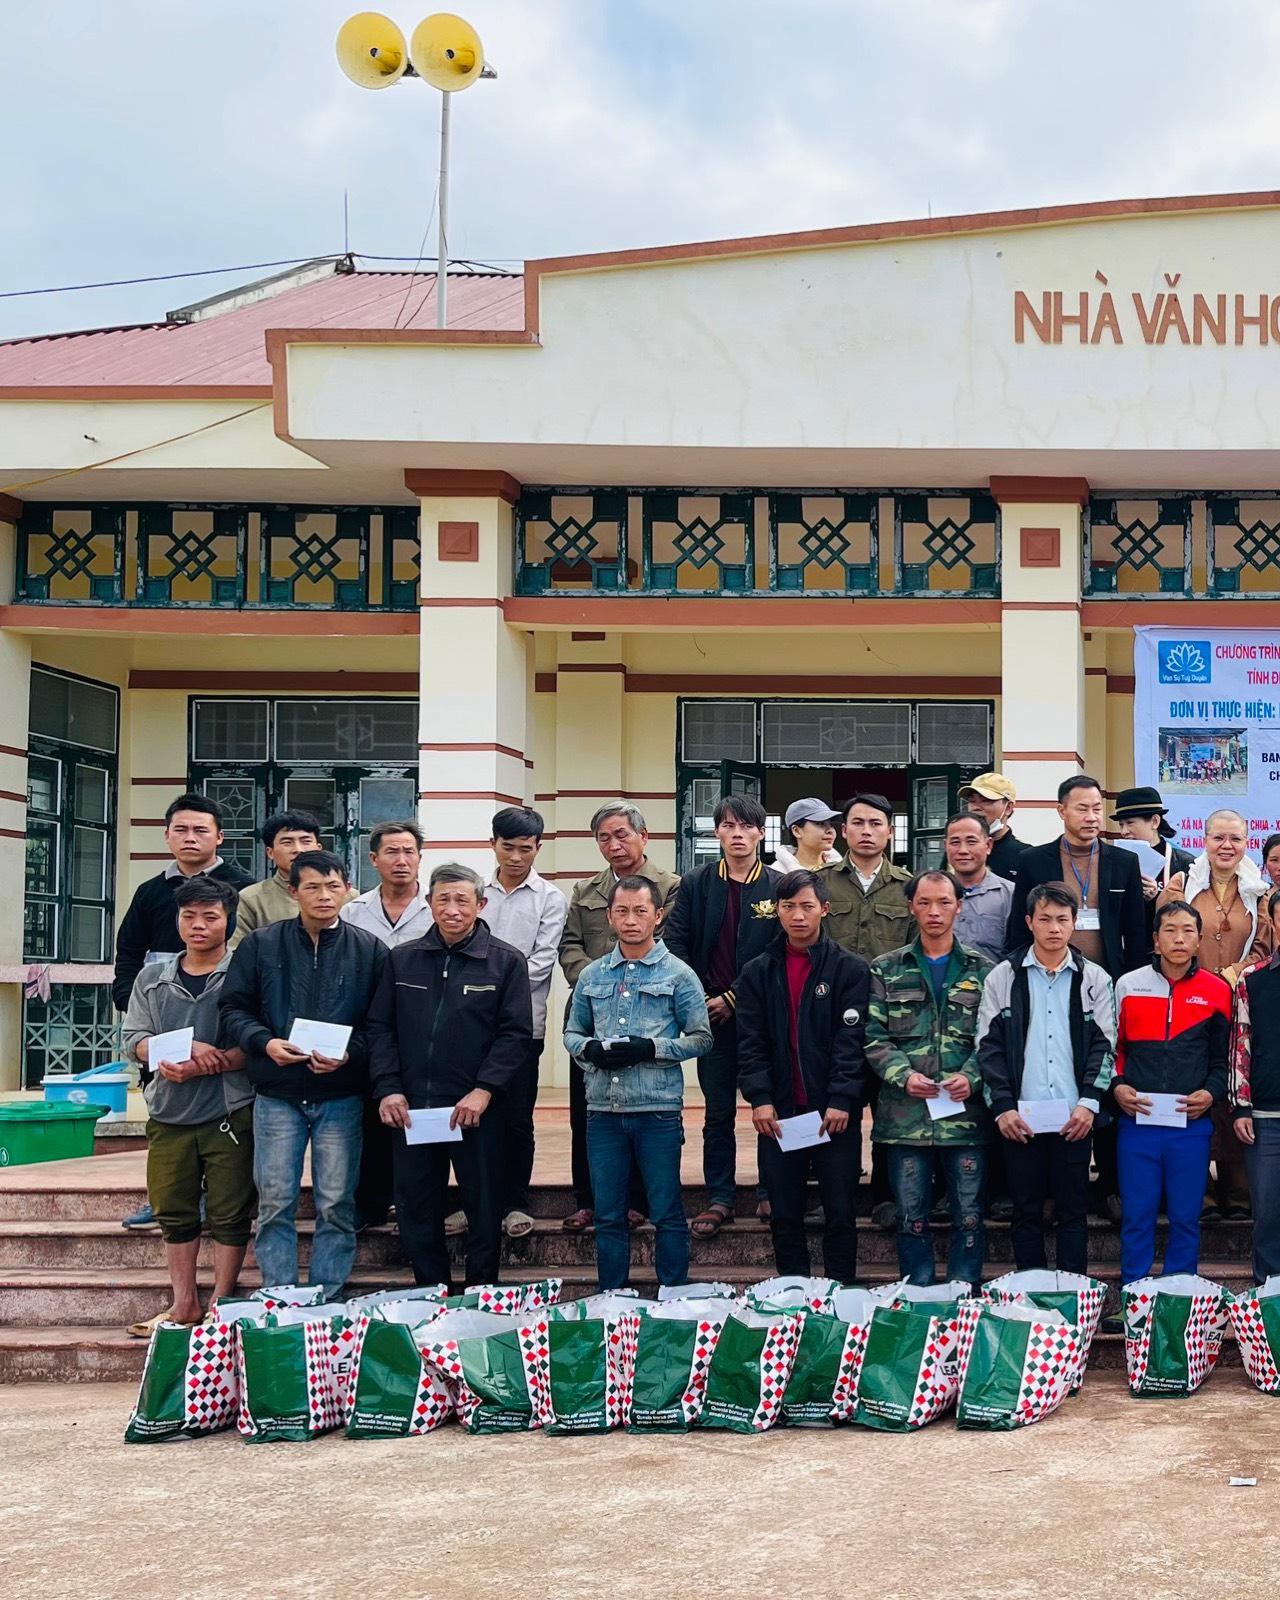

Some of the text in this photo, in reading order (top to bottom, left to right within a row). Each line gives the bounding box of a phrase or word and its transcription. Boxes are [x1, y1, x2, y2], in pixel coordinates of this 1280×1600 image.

[1013, 270, 1123, 346] NHÀ
[1131, 272, 1226, 347] VĂN
[1215, 643, 1257, 659] CHƯƠNG
[1170, 700, 1194, 718] ĐƠN
[1198, 702, 1209, 722] VỊ
[1212, 701, 1242, 722] THỰC
[1250, 819, 1269, 831] CHUA
